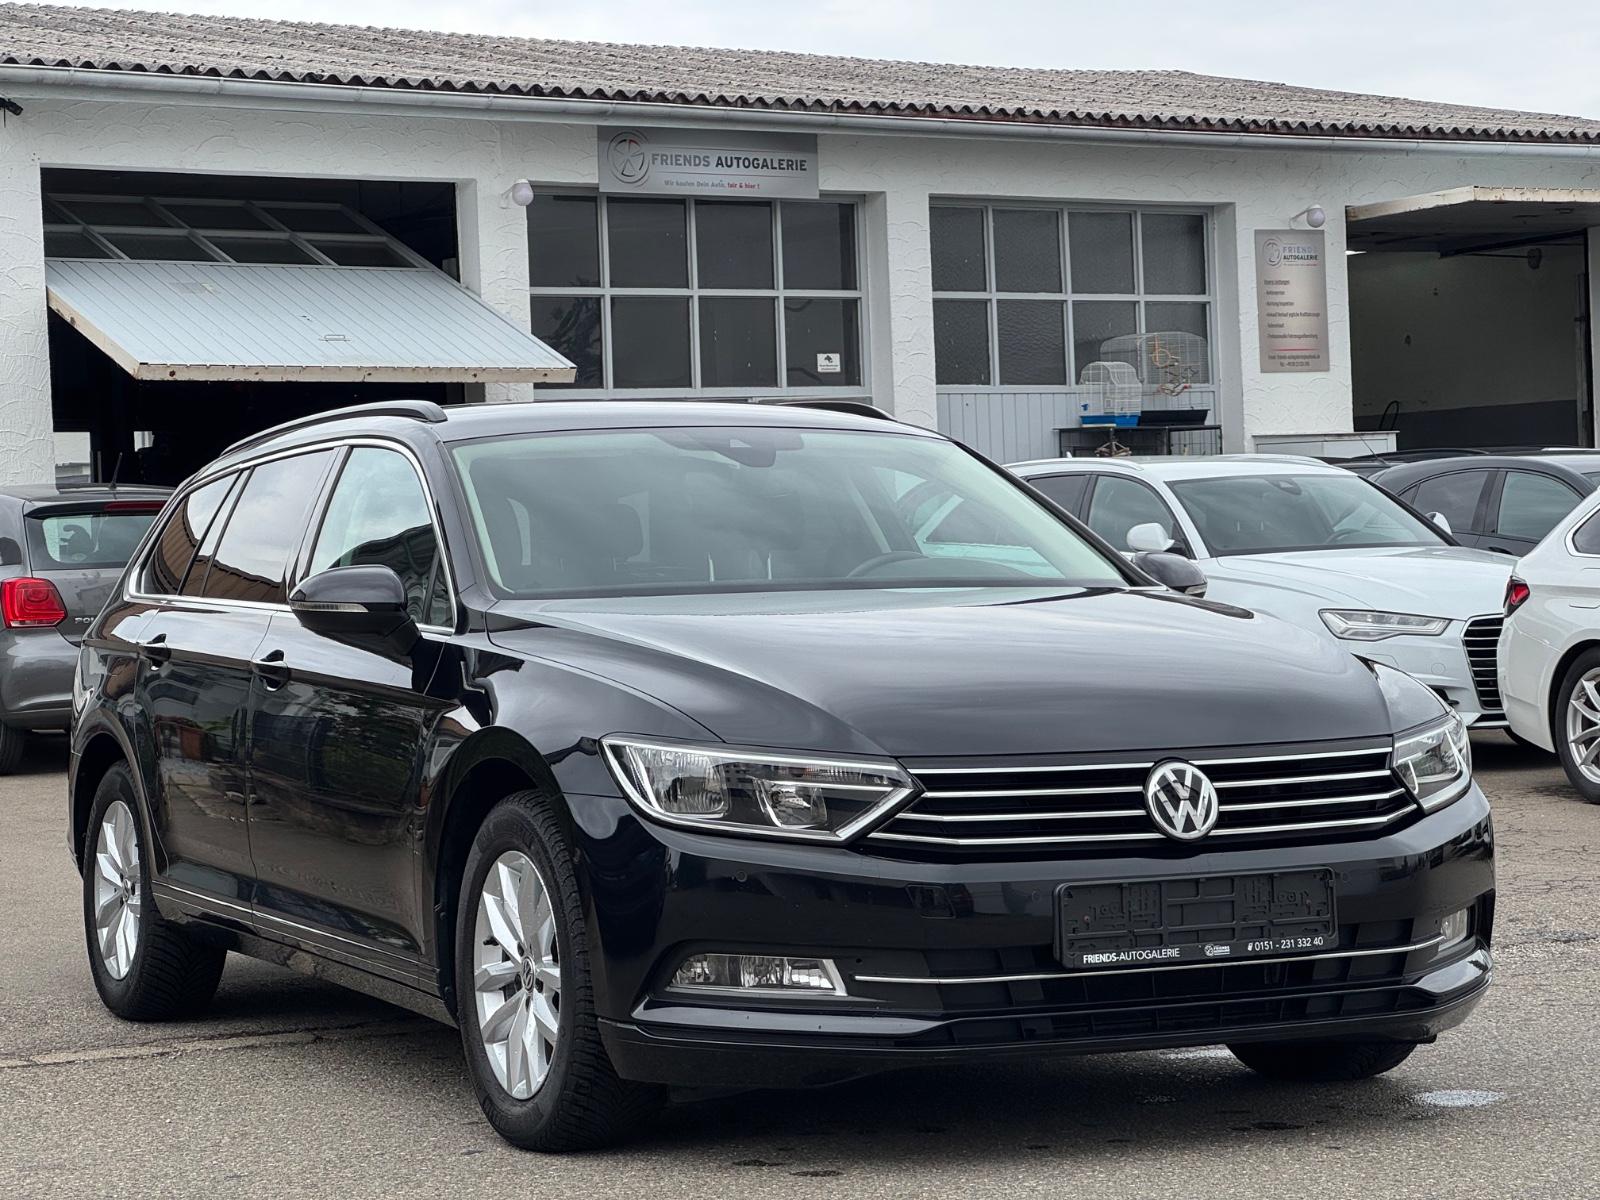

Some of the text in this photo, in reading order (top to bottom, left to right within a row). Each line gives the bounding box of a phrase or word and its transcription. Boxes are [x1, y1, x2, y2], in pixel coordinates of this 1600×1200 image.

[651, 153, 808, 172] FRIENDS AUTOGALERIE
[1283, 246, 1318, 254] FRIEND
[1152, 765, 1213, 835] VW
[1254, 941, 1274, 951] 0151
[1281, 939, 1295, 949] 231
[1297, 937, 1312, 947] 332
[1313, 936, 1324, 946] 40
[1083, 948, 1180, 964] FRIENDS-AUTOGALERIE
